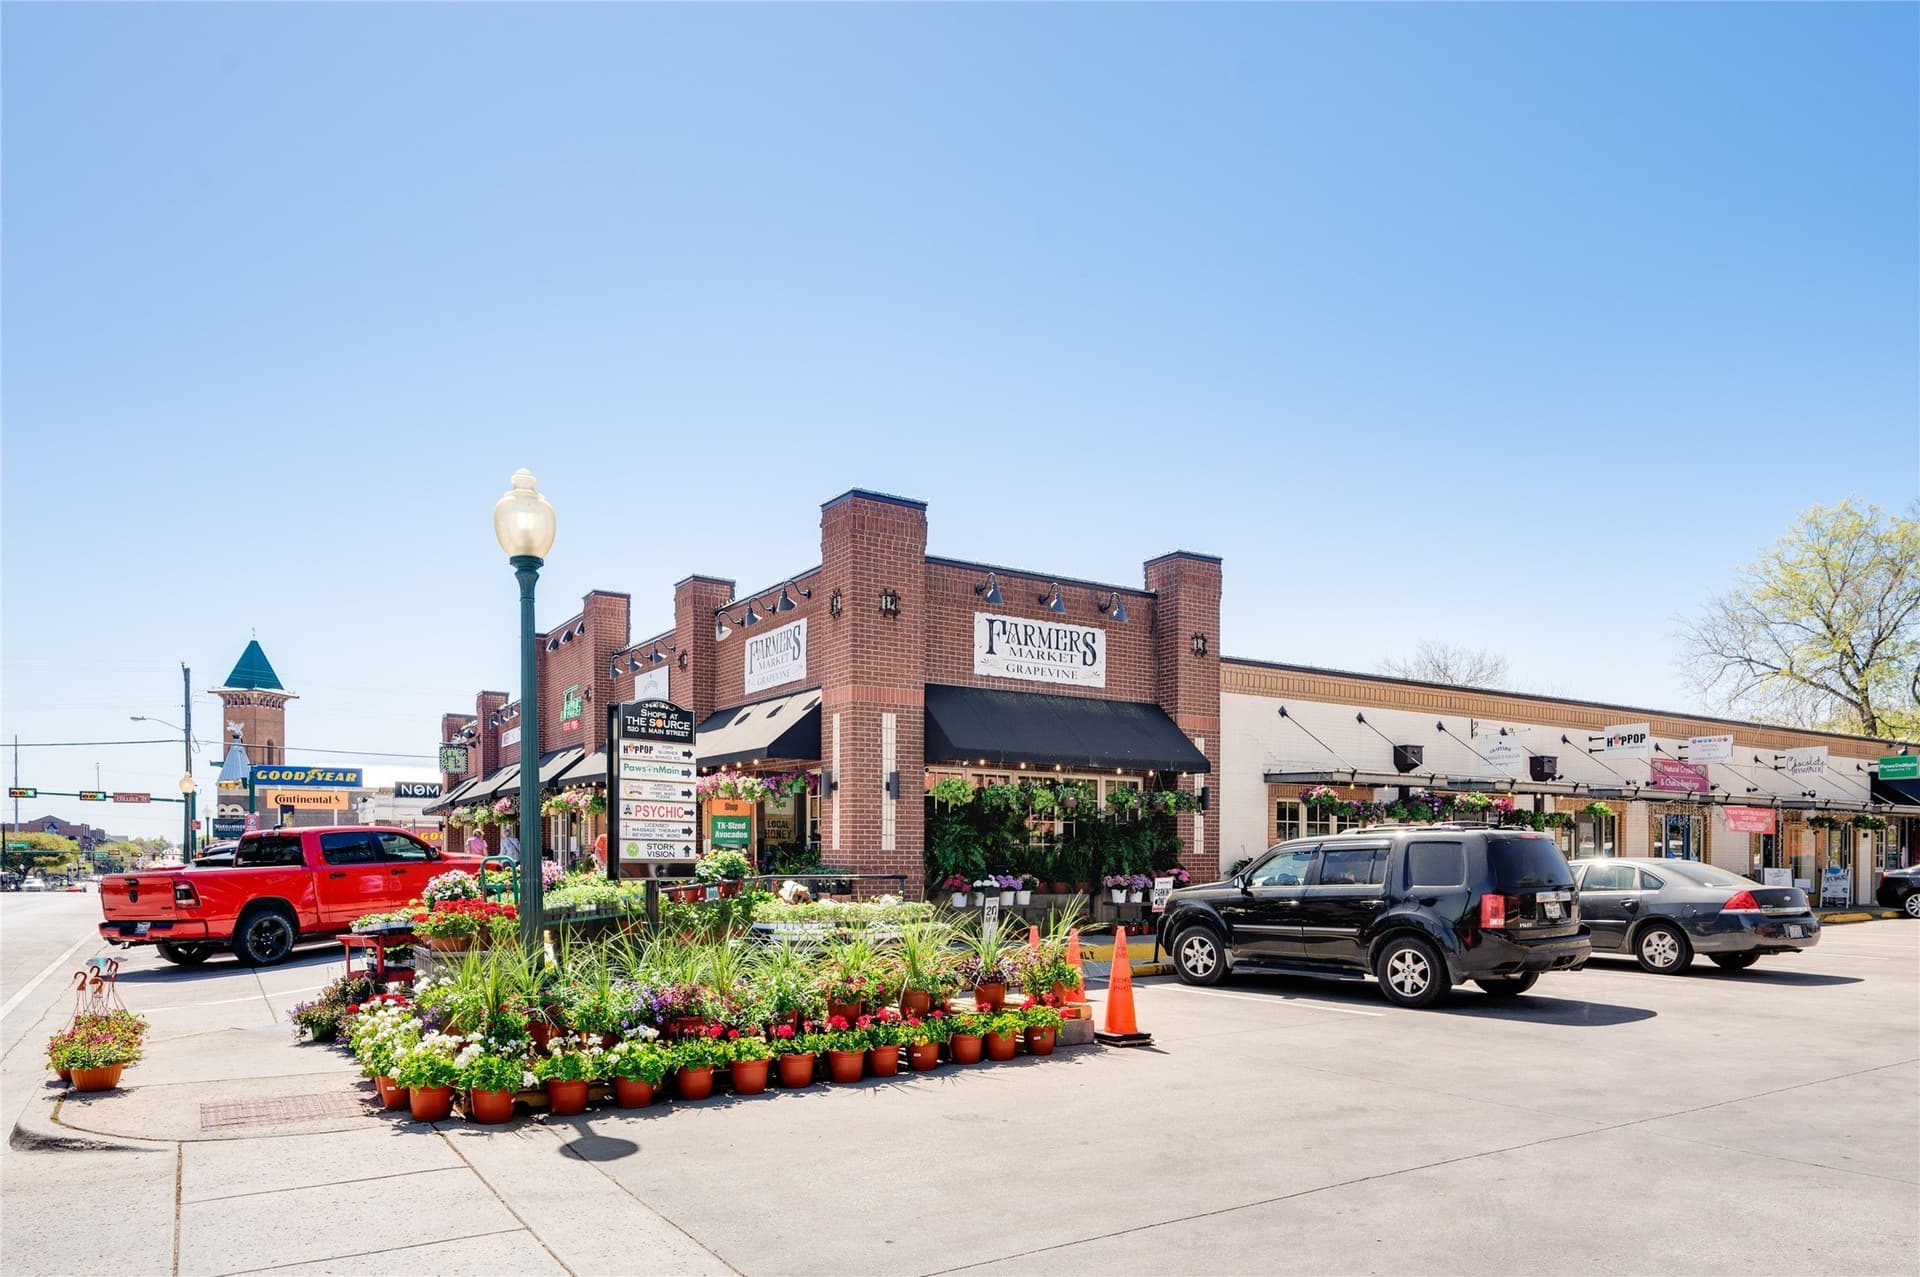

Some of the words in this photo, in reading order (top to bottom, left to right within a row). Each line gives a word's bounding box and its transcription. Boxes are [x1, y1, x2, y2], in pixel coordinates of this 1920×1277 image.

[985, 618, 1097, 666] FARMERS
[749, 624, 800, 675] FARMERS
[1009, 647, 1077, 664] MARKET
[758, 653, 790, 670] MARKET
[757, 669, 790, 685] GRAPEVINE
[1006, 663, 1078, 680] GRAPEVINE
[641, 709, 667, 719] SHOPS
[625, 715, 647, 727] THE
[649, 718, 691, 731] SOURCE
[256, 768, 357, 784] GOODYEAR
[274, 794, 332, 804] Continental
[634, 805, 685, 819] PSYCHIC
[724, 803, 738, 812] Shop
[717, 821, 746, 830] TX-Sized
[768, 820, 789, 829] LOCAL
[764, 829, 792, 839] HONEY
[646, 843, 675, 851] STORK
[986, 905, 997, 916] 20
